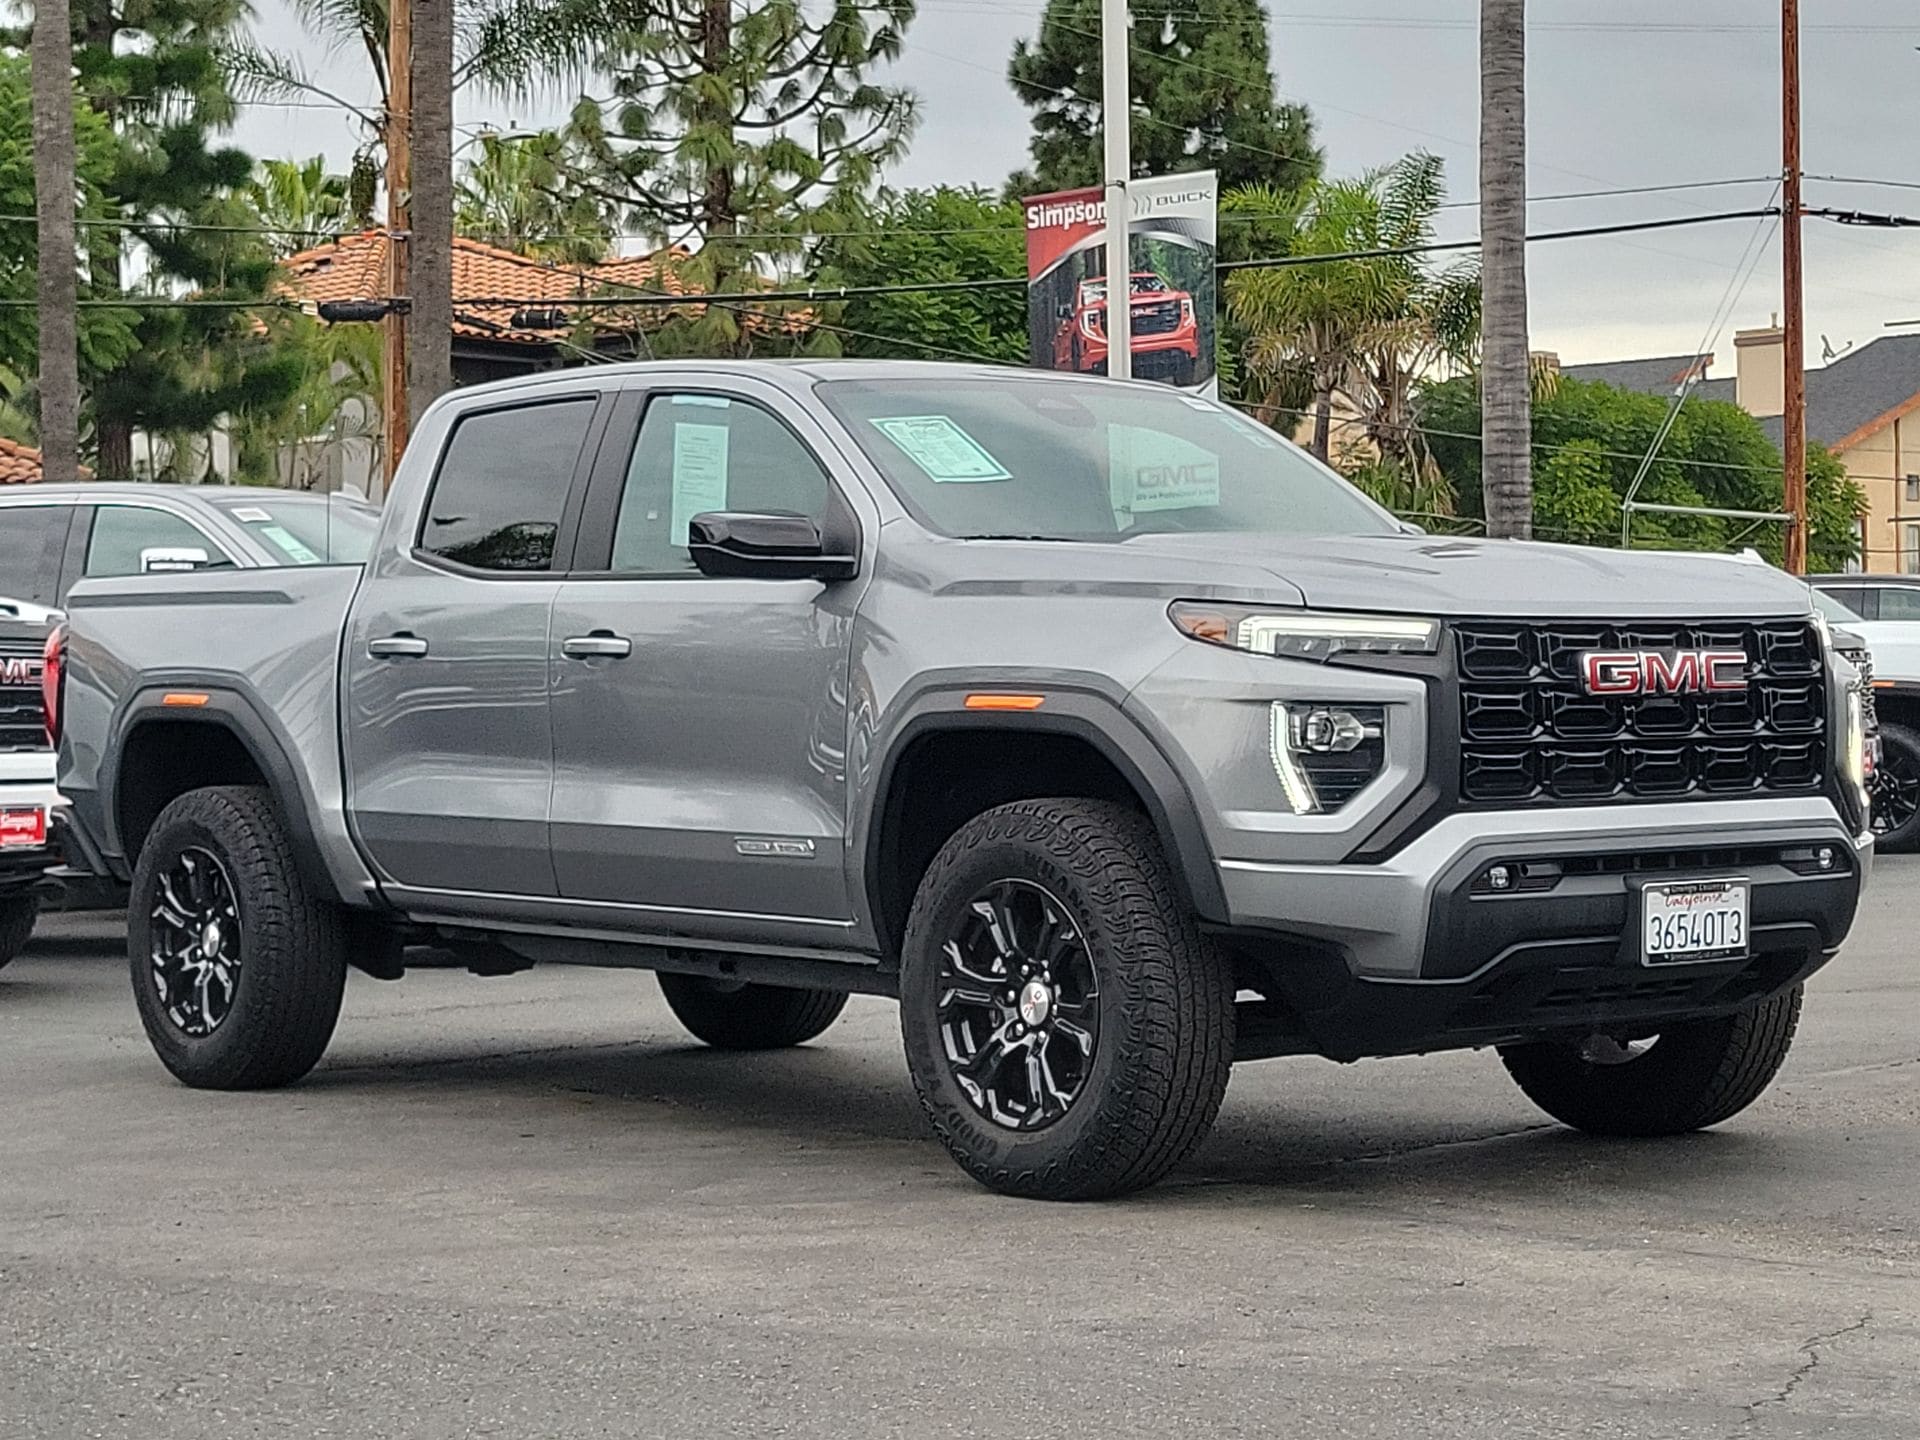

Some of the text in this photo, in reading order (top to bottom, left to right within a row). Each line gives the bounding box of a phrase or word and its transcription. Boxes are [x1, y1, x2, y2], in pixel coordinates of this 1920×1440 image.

[1156, 190, 1212, 206] BUICK
[1027, 201, 1107, 231] Simpson
[1137, 463, 1216, 488] GMC
[1583, 651, 1748, 697] GMC
[1665, 892, 1729, 911] California
[1651, 910, 1741, 951] 36540T3
